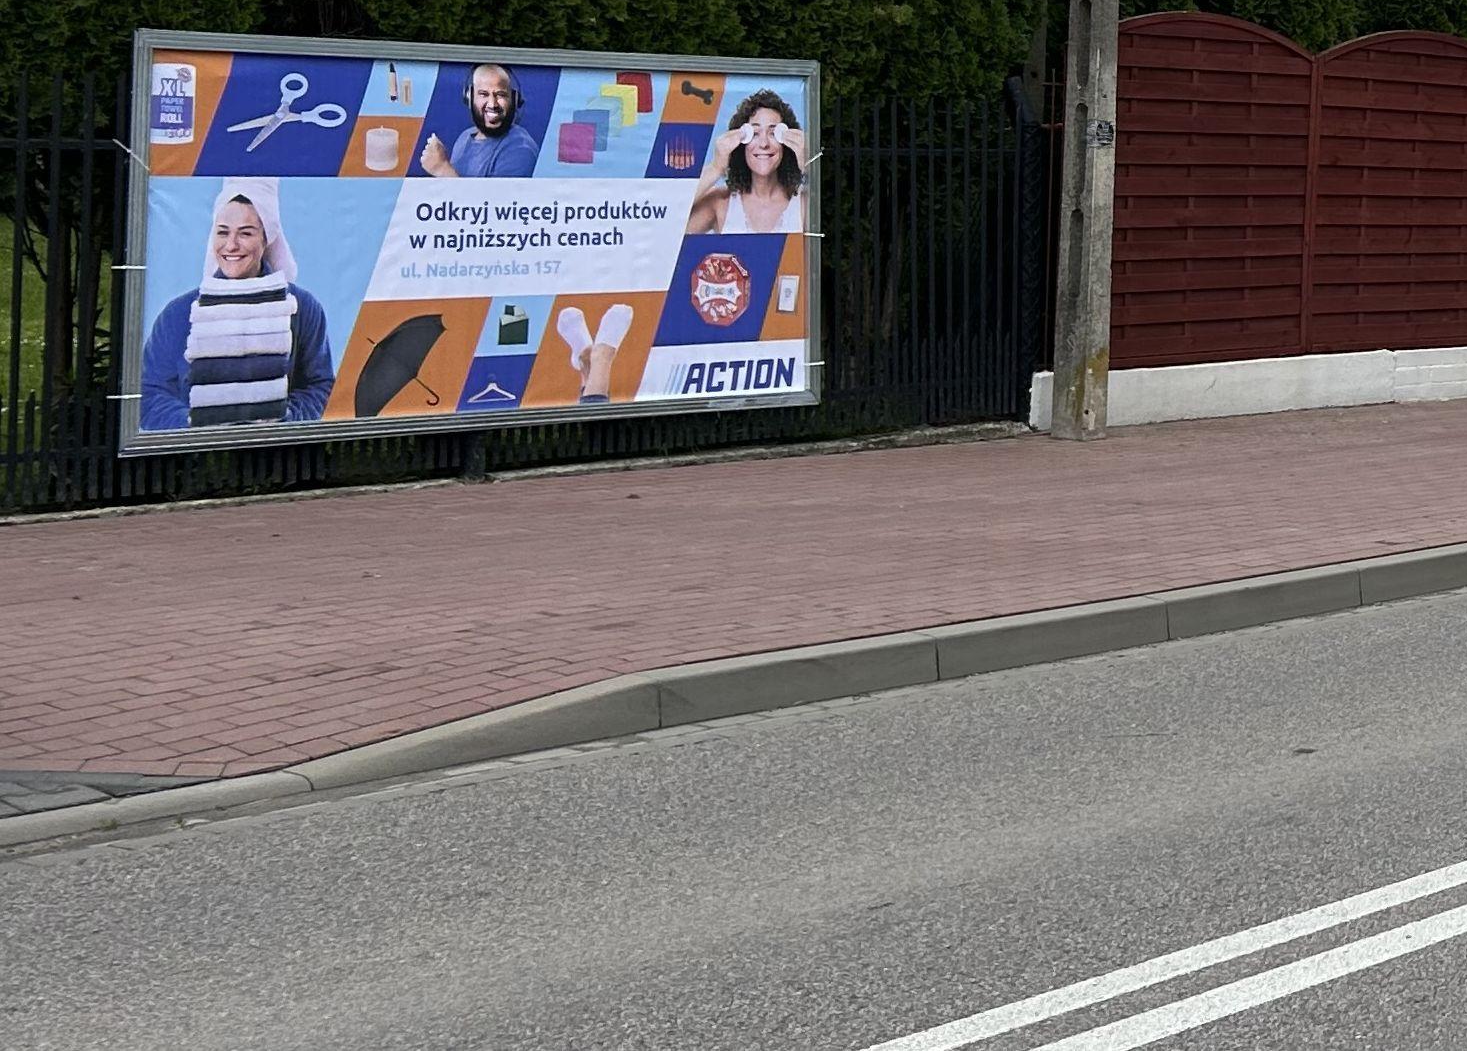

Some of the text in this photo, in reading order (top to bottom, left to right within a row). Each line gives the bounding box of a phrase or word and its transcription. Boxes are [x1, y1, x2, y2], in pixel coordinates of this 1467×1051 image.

[161, 78, 185, 97] XL
[416, 200, 668, 225] Odkryj więcej produktów
[409, 227, 624, 252] w najniższych cenach
[401, 260, 562, 280] ul. Nadarzyńska 157
[682, 357, 795, 394] ACTION
